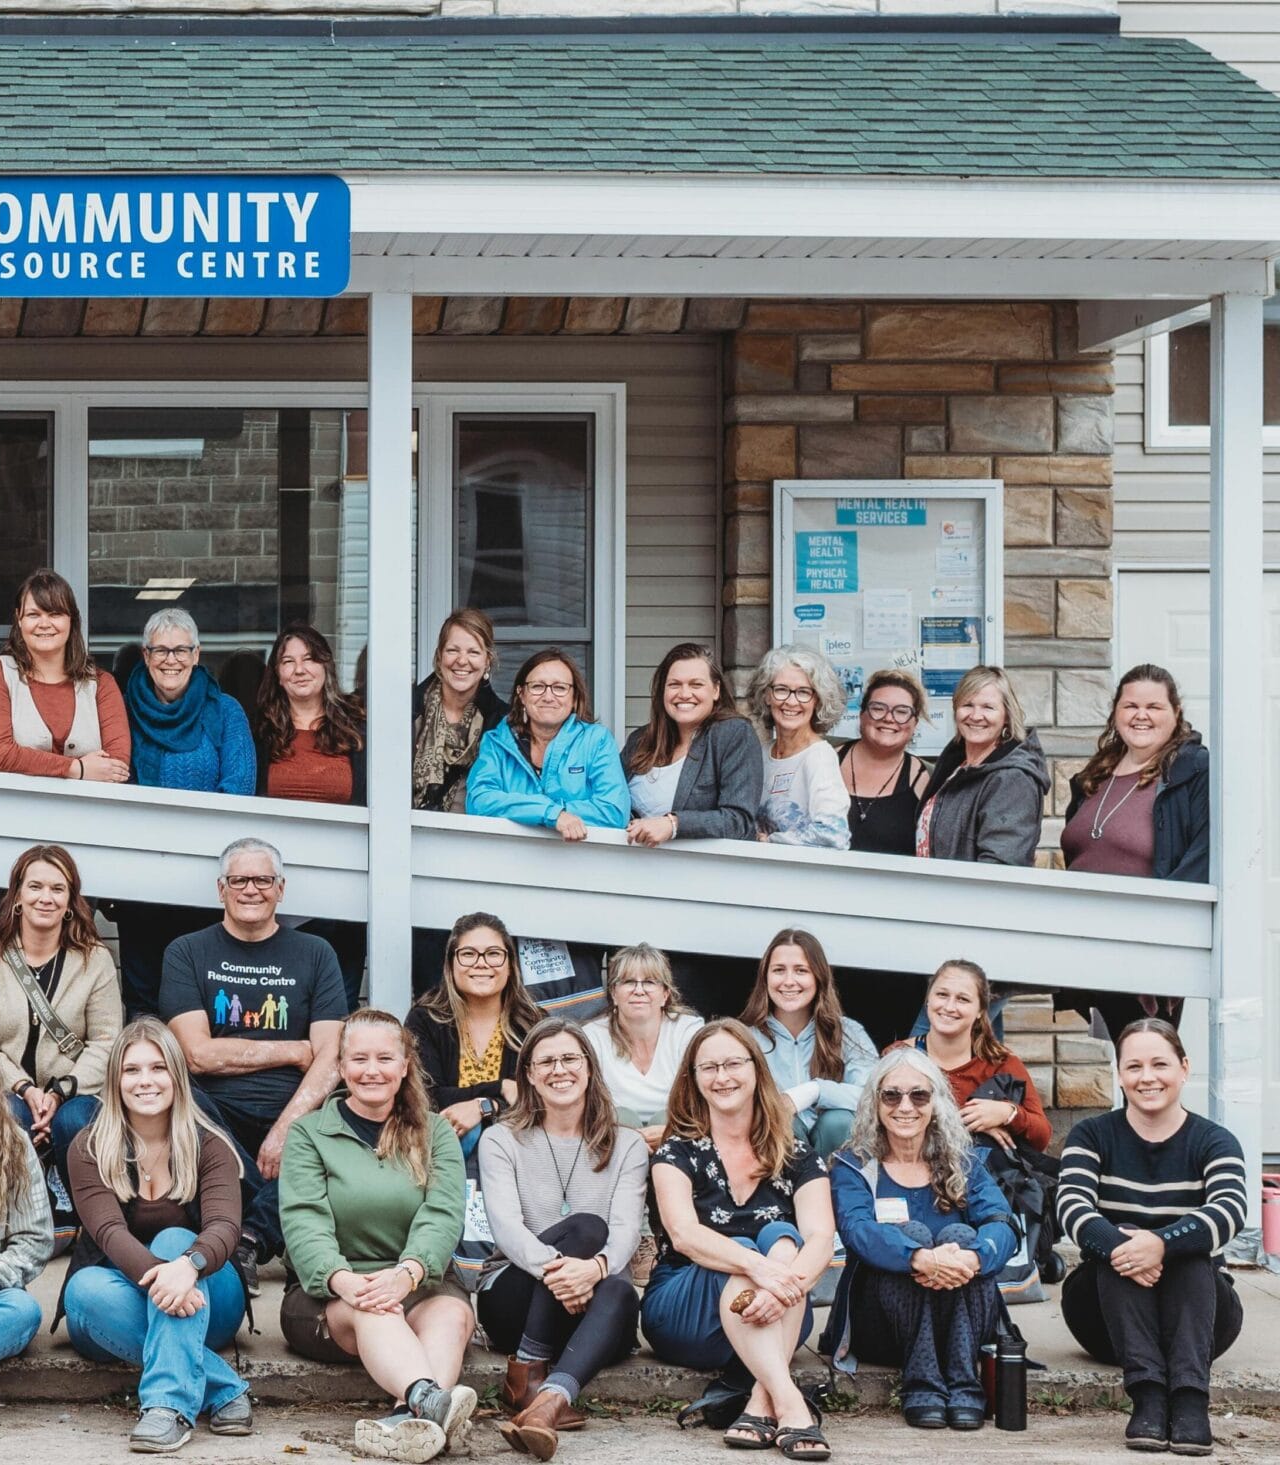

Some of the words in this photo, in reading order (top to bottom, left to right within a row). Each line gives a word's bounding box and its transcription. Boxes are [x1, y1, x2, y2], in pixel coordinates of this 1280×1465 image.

[176, 251, 320, 279] CENTRE
[837, 498, 881, 510] MENTAL
[884, 498, 926, 510] HEALTH
[856, 511, 908, 524] SERVICES
[808, 536, 844, 546] MENTAL
[809, 547, 844, 557] HEALTH
[806, 568, 848, 578] PHYSICAL
[810, 579, 845, 590] HEALTH
[893, 650, 918, 668] NEW
[221, 961, 282, 976] Community
[207, 970, 257, 986] Resource
[260, 976, 296, 986] Centre
